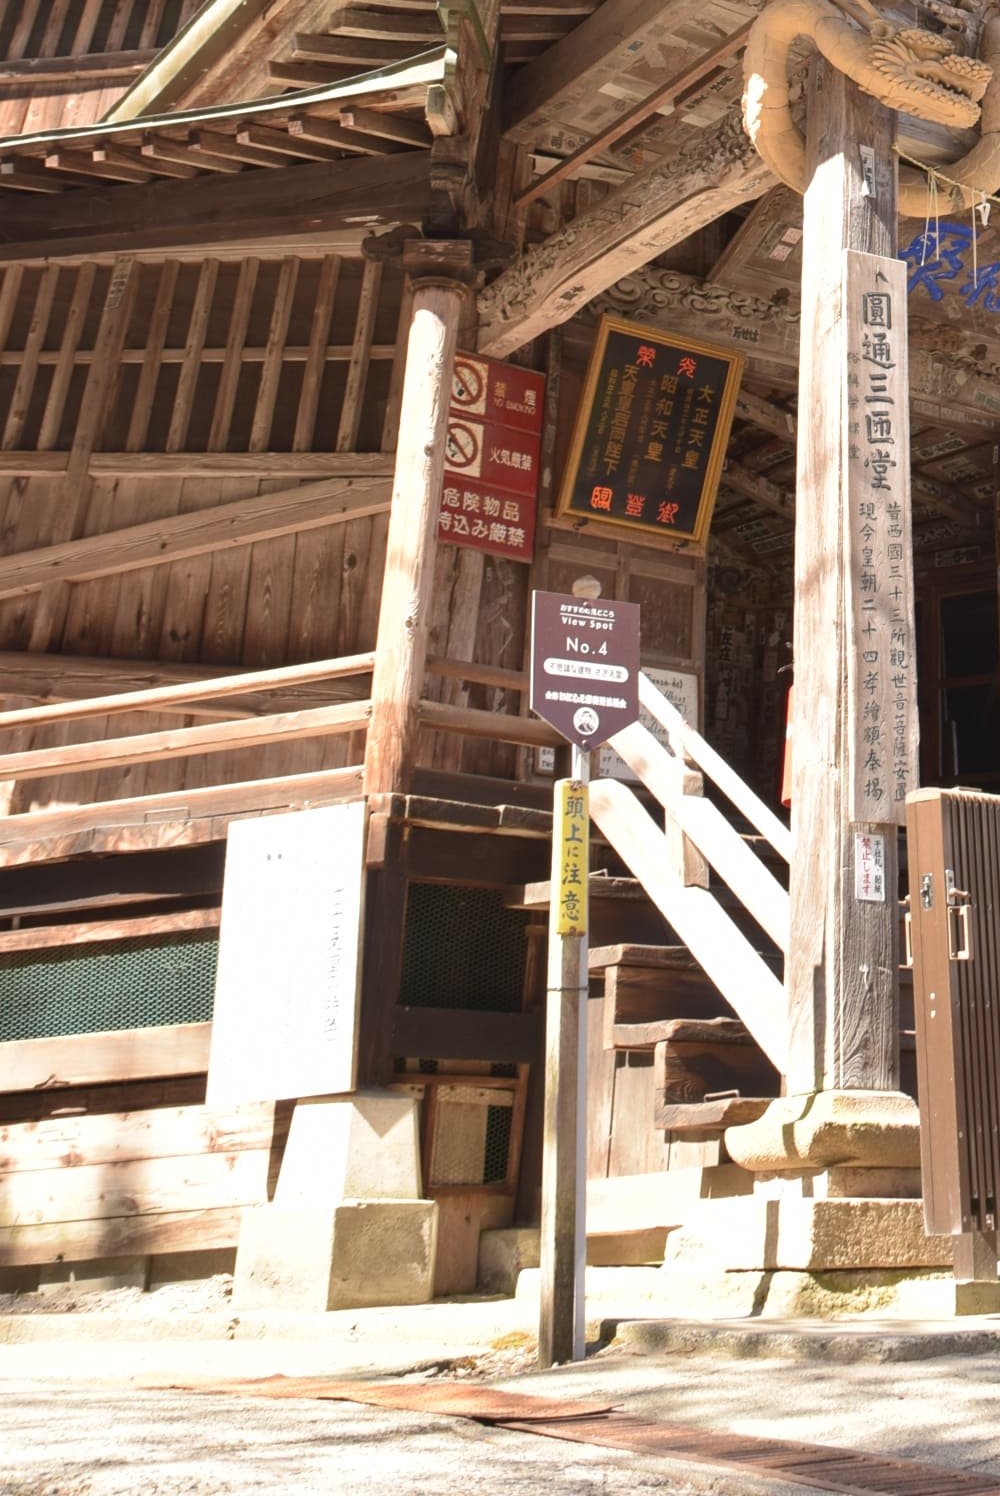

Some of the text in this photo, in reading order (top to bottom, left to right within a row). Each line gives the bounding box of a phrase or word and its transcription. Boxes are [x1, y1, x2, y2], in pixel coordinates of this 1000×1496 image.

[647, 374, 679, 462] 昭和天皇
[682, 384, 717, 471] 大正天皇
[489, 447, 533, 471] 火気厳禁
[443, 488, 520, 522] 危険物品
[561, 616, 613, 631] View Spot
[566, 637, 608, 656] No.4
[561, 795, 585, 922] 頭上に注意
[862, 837, 871, 896] 禁止します
